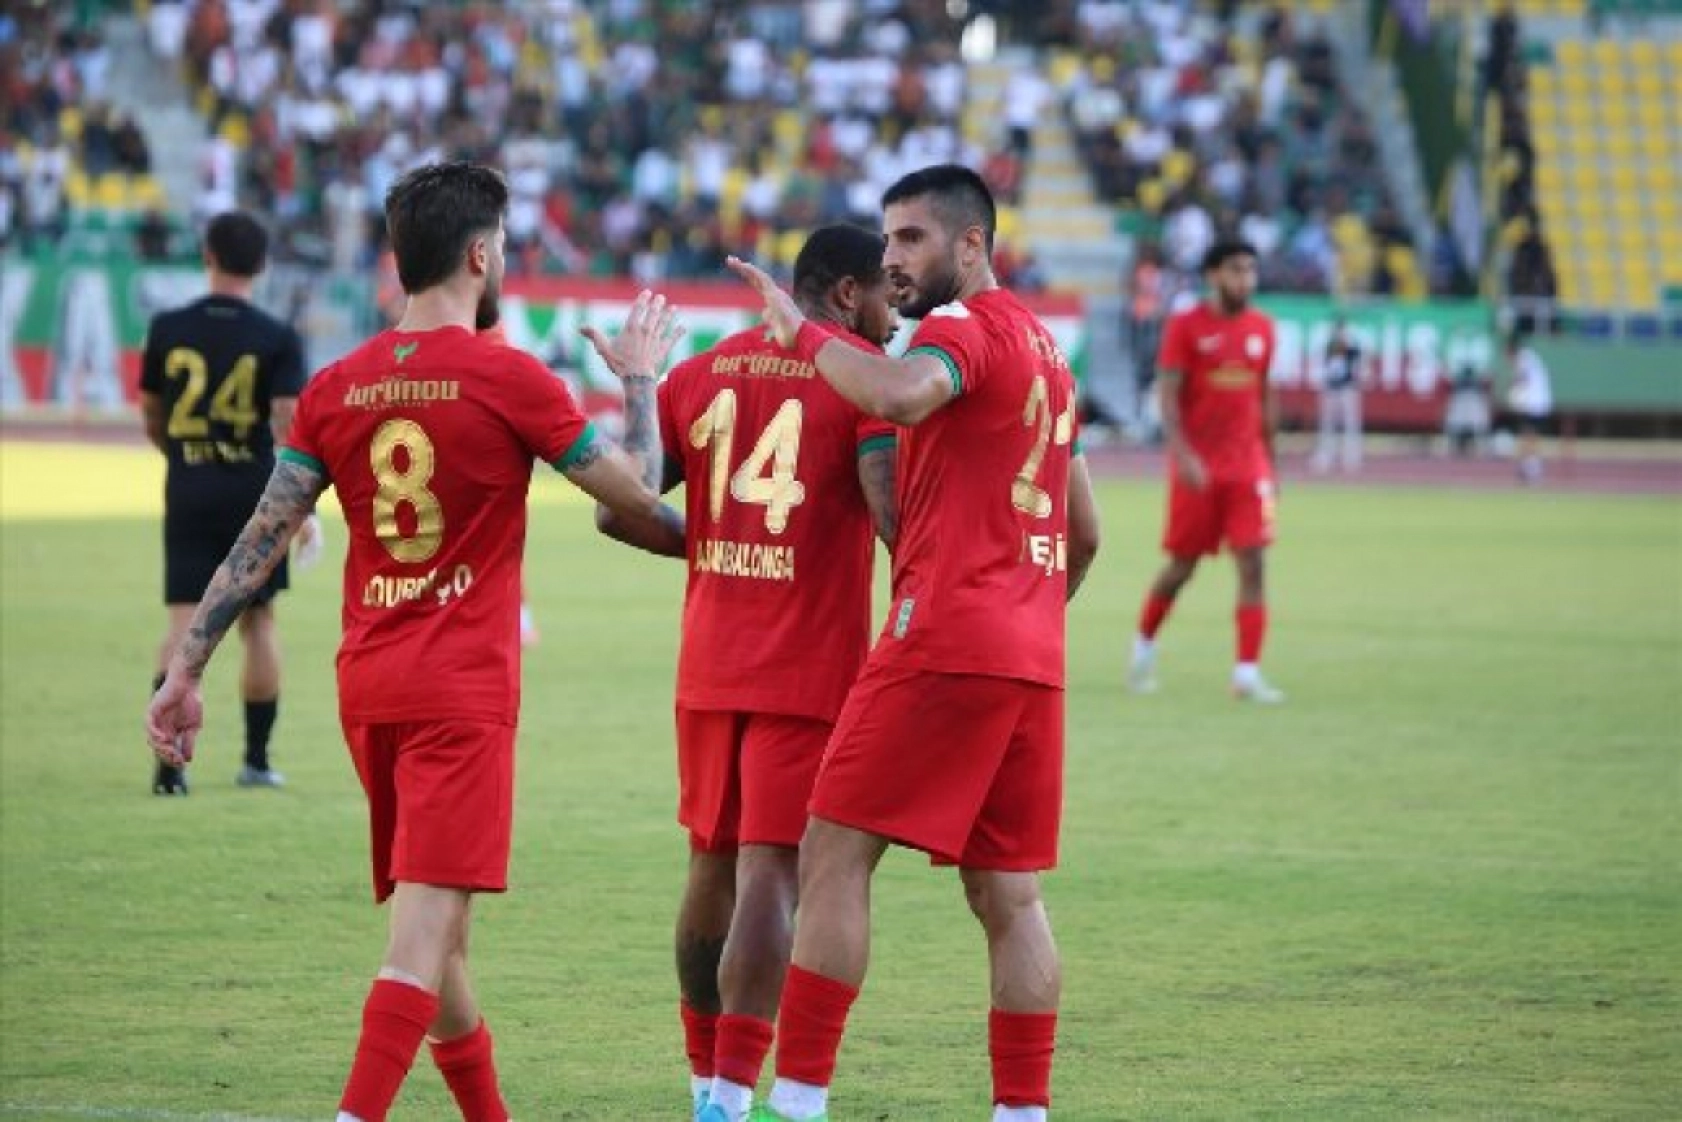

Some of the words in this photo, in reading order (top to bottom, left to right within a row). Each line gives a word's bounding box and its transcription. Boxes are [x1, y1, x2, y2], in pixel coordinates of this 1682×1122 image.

[165, 349, 257, 438] 24
[689, 388, 804, 534] 14
[370, 420, 443, 564] 8
